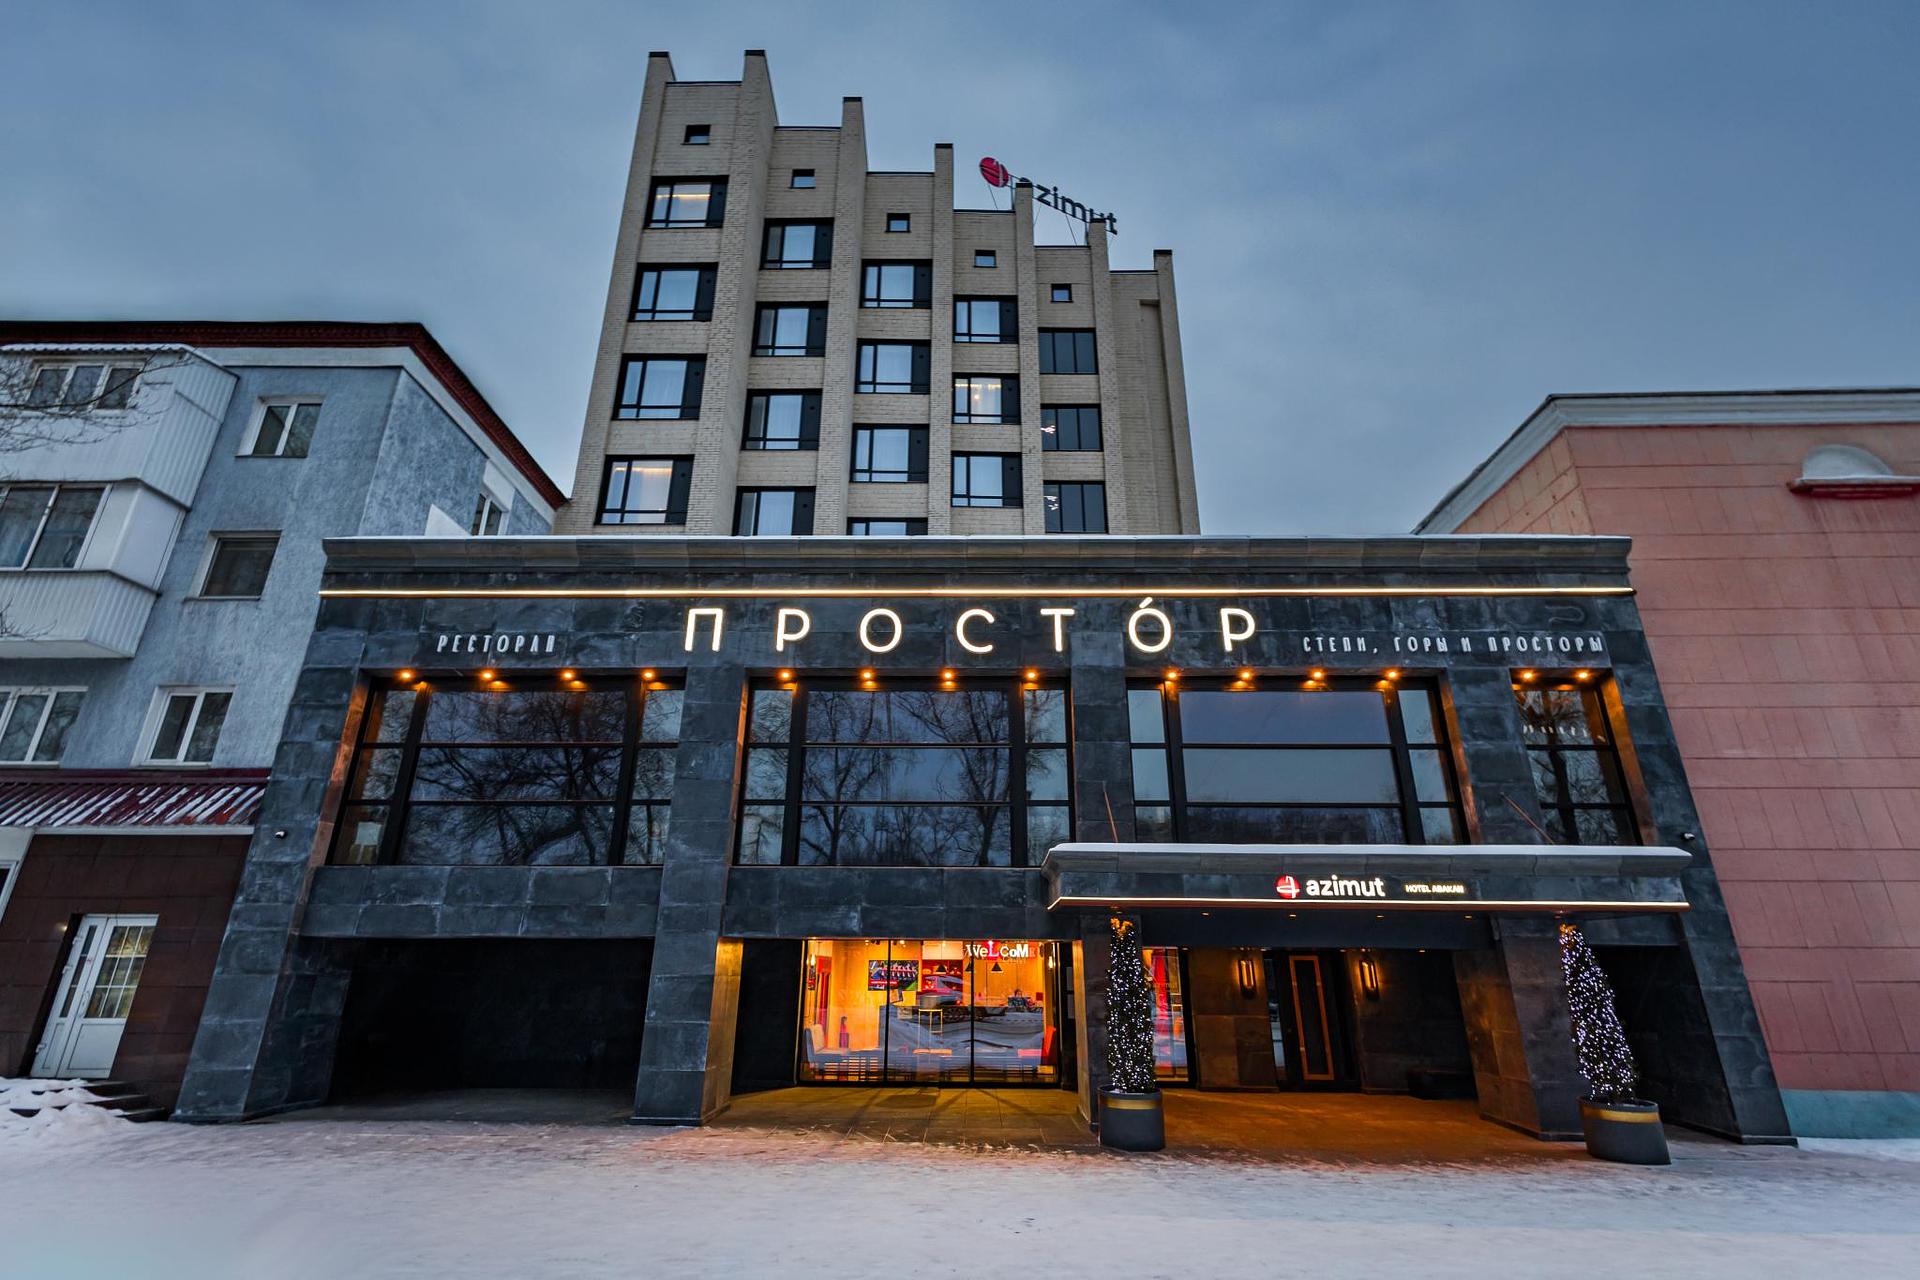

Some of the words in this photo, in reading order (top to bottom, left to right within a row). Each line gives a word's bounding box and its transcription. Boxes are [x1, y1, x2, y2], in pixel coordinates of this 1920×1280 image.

[436, 634, 556, 653] РЕСТОРАН
[1302, 636, 1378, 654] СТЕПИ,
[1393, 636, 1449, 653] ГОРЫ
[1460, 636, 1472, 653] И
[1487, 636, 1603, 653] ПРОСТОРЫ
[1305, 874, 1386, 897] azimut
[1405, 884, 1431, 893] HOTEL
